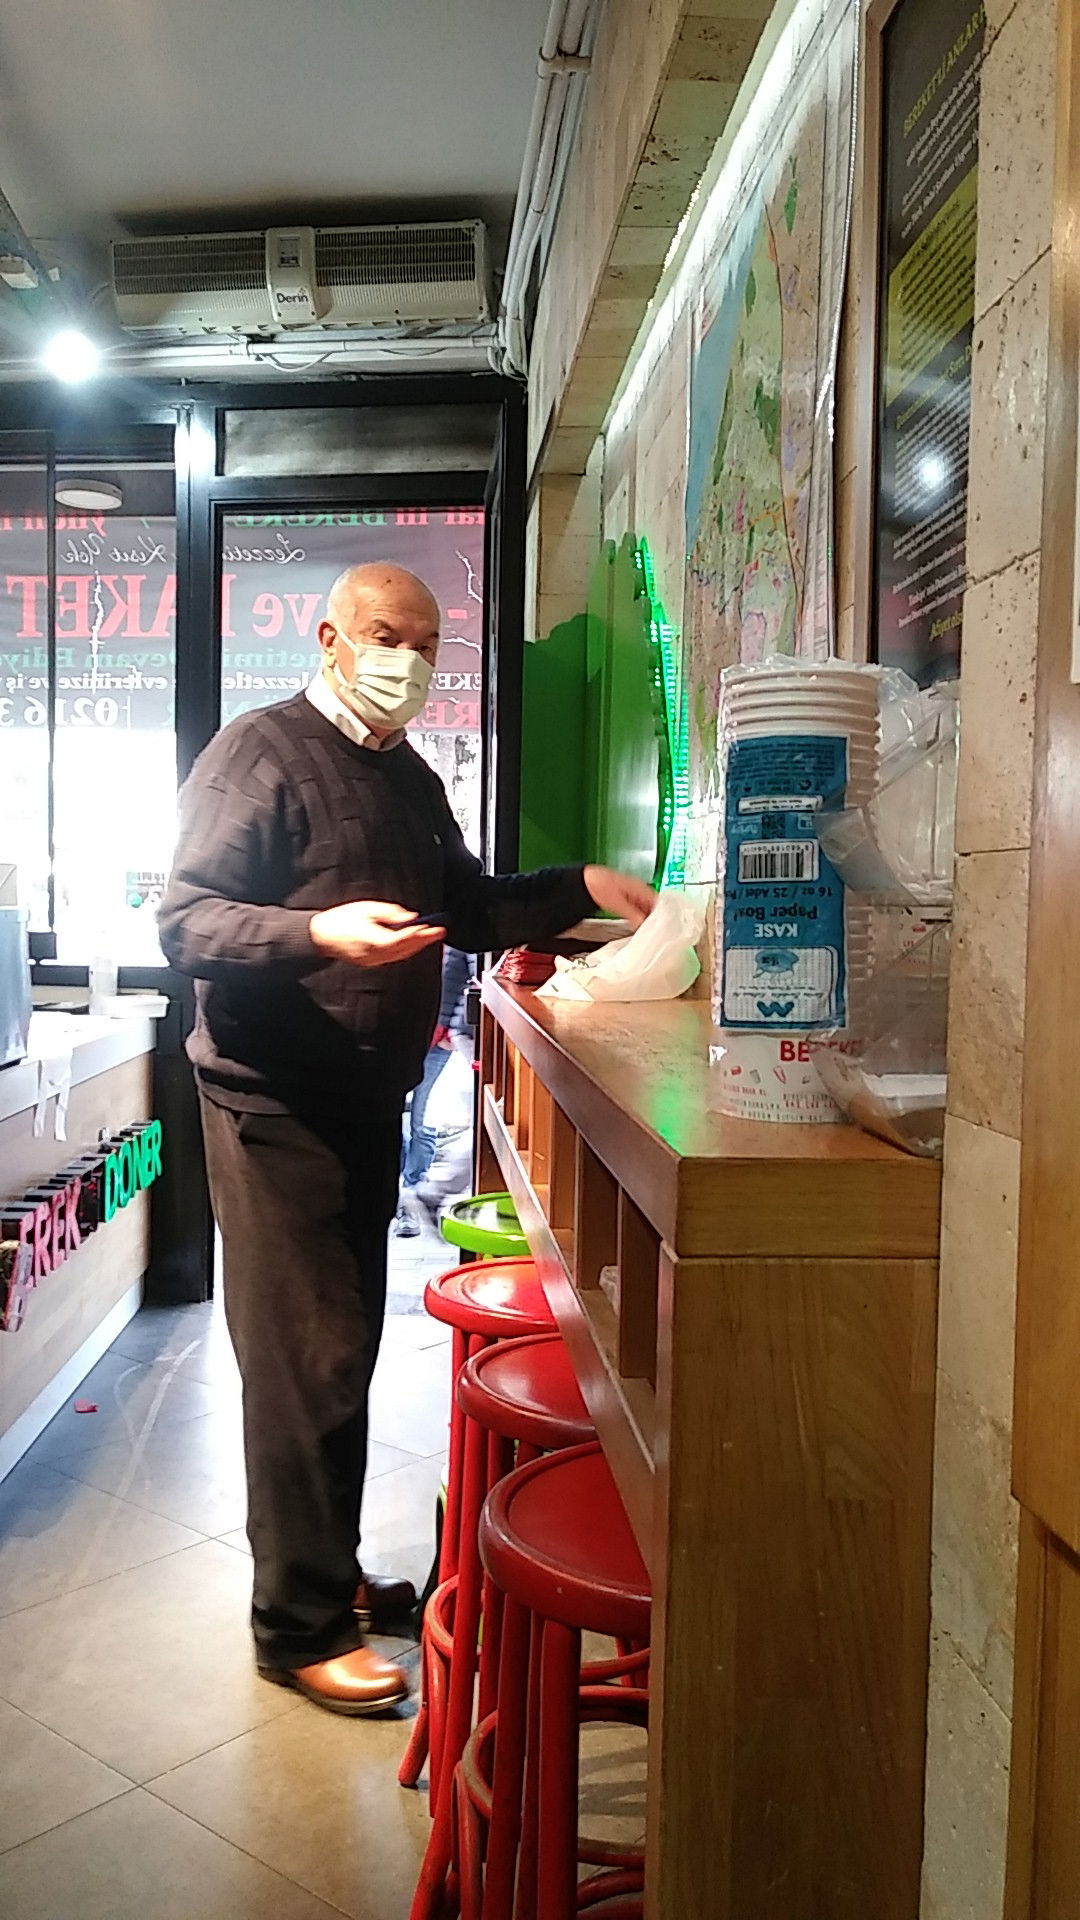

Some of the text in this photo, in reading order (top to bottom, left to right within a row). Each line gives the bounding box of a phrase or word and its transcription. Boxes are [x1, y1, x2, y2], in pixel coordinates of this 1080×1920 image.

[276, 292, 309, 304] Derin
[745, 887, 770, 899] Adet
[773, 887, 788, 898] 25
[818, 886, 833, 897] 16
[770, 902, 818, 920] Paper
[754, 923, 798, 938] KASE
